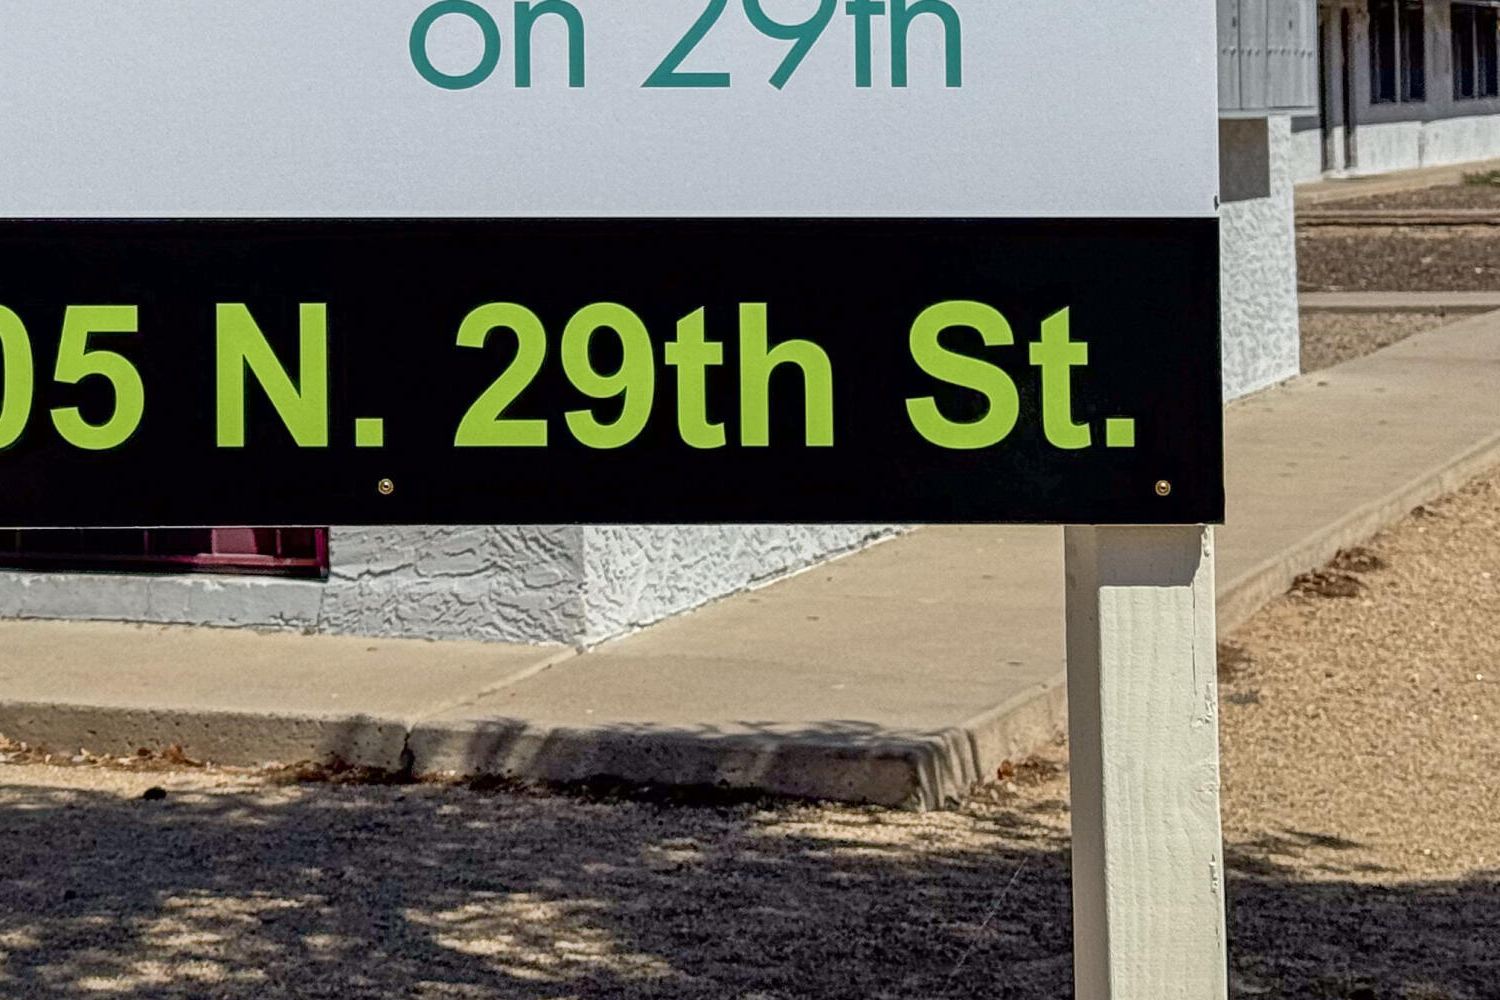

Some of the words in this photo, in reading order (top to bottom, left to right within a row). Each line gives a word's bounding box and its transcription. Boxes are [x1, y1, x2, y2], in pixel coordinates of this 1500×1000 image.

[409, 0, 585, 90] on
[217, 303, 384, 448] N.
[455, 302, 834, 449] 29th
[906, 300, 1135, 450] St.
